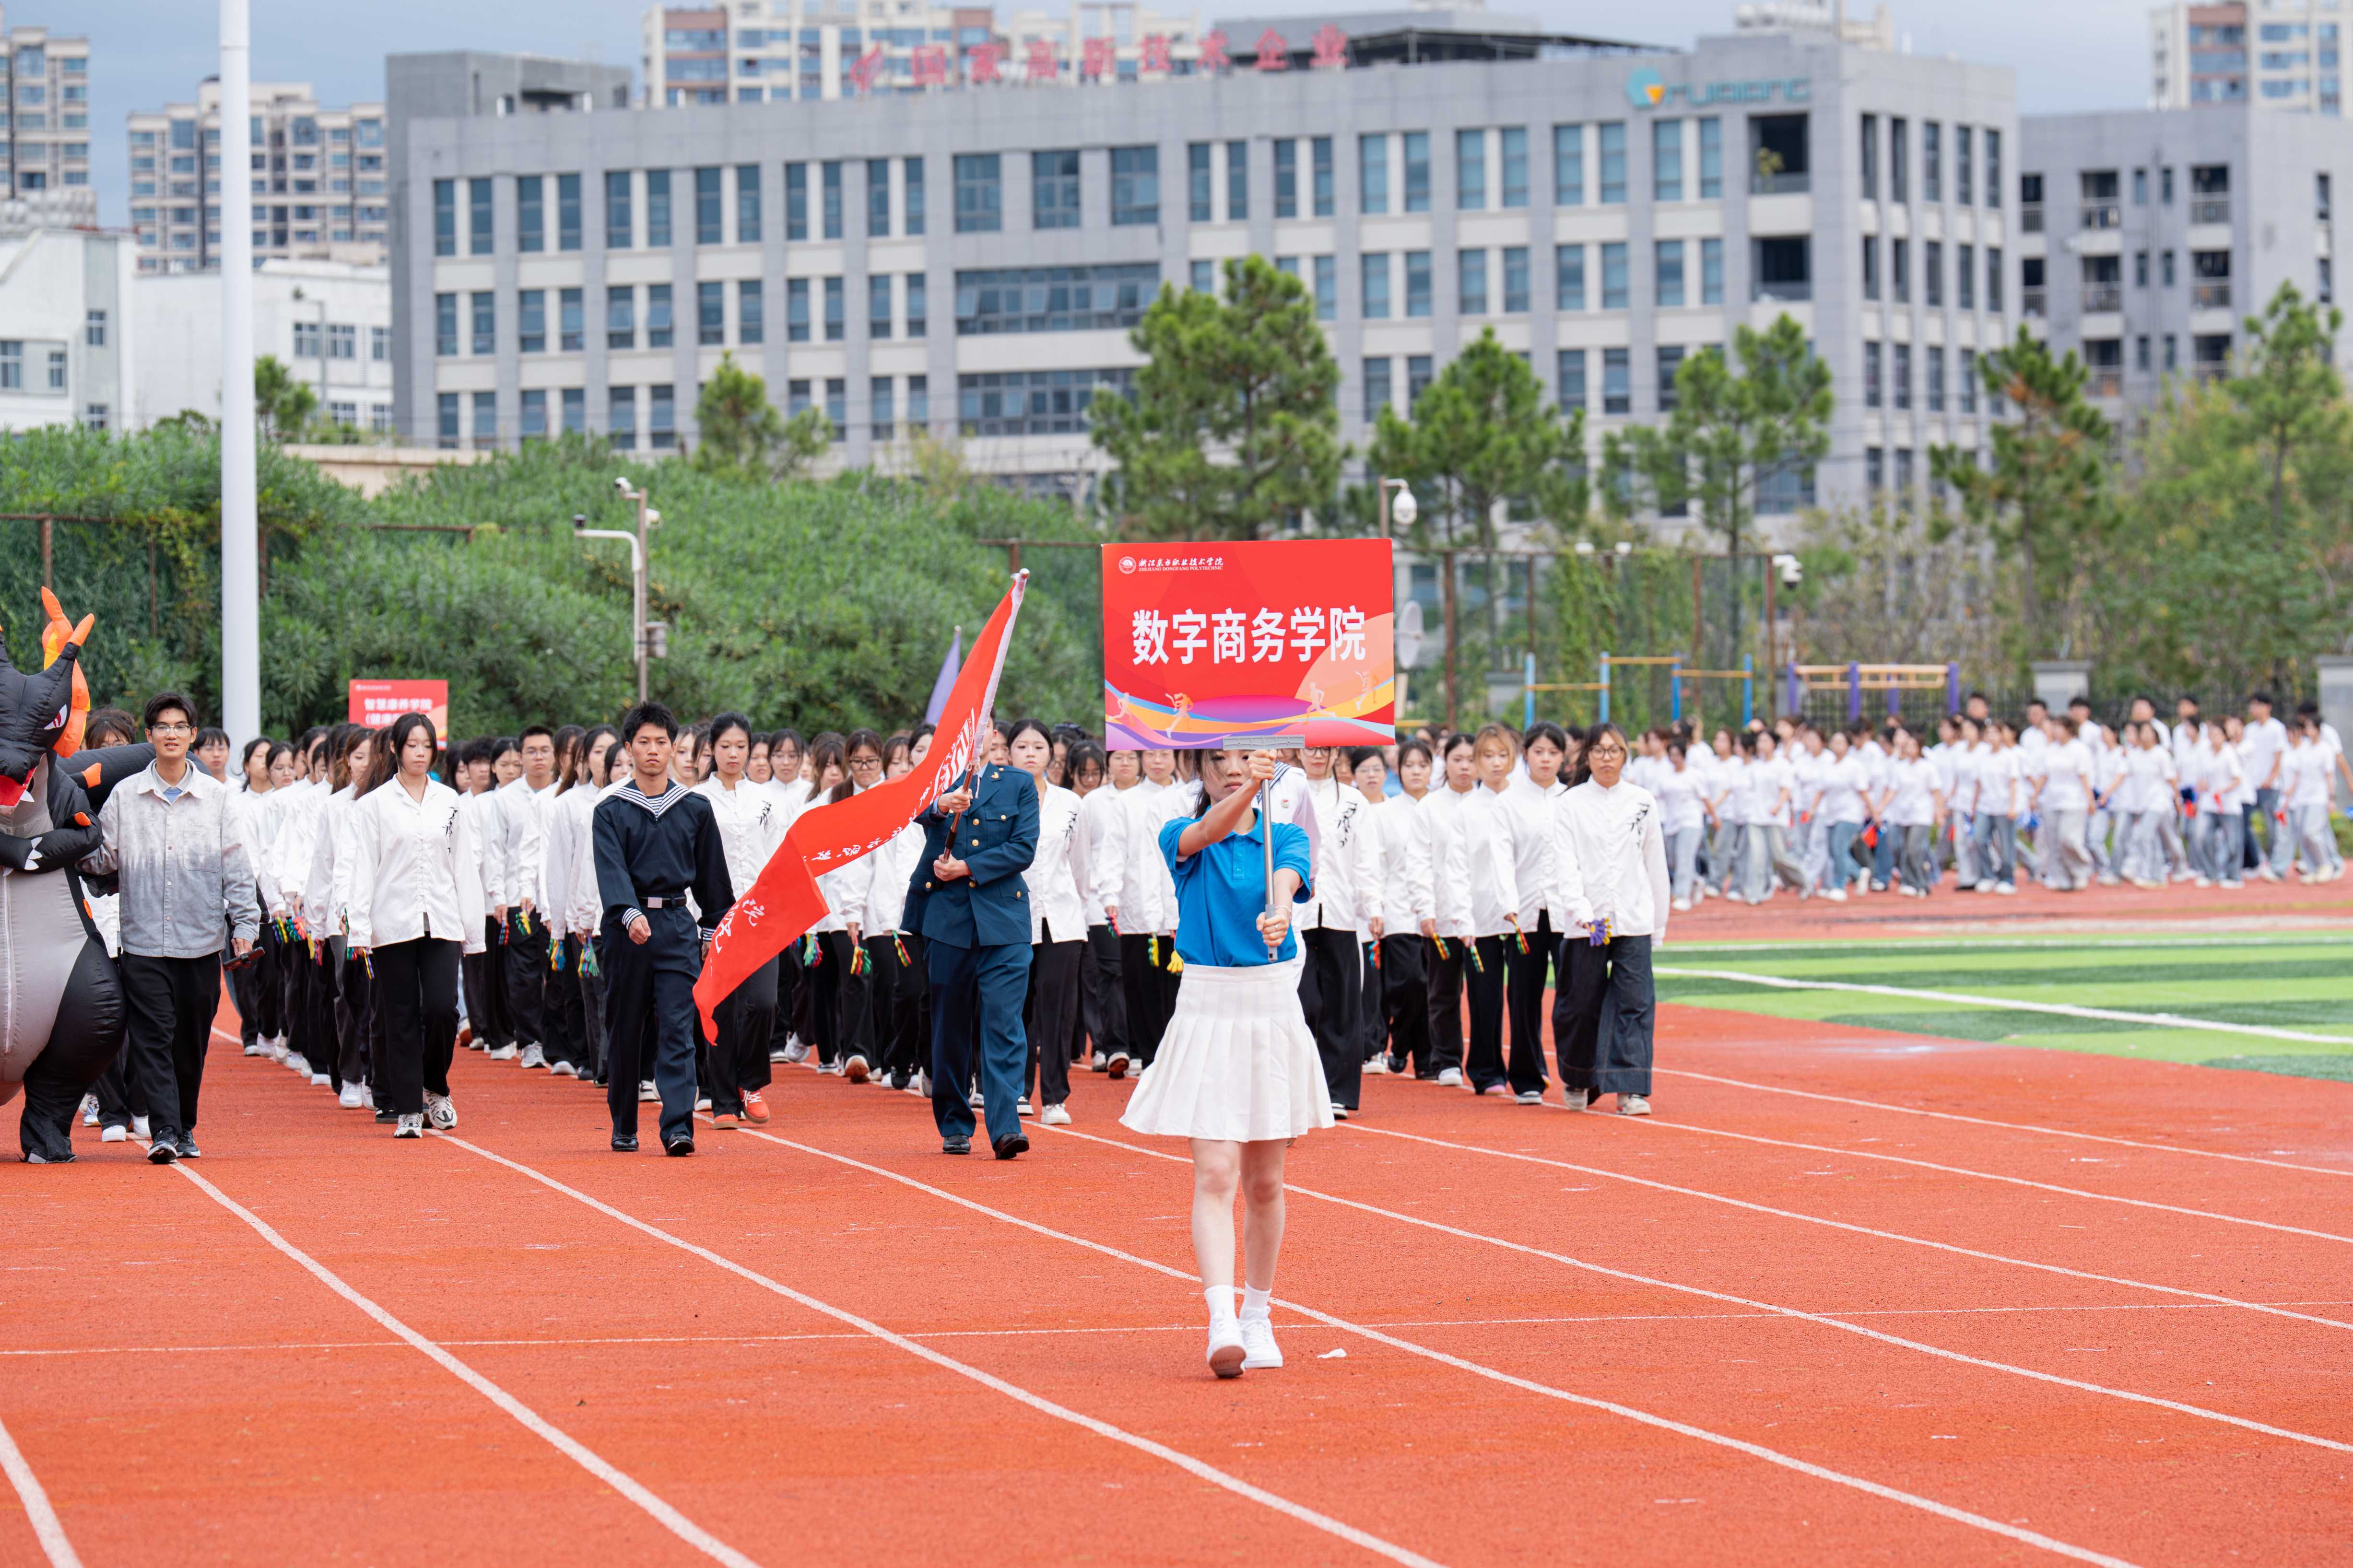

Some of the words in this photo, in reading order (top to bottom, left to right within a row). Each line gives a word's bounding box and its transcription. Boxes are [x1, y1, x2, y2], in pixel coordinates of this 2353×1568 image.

[1139, 557, 1224, 567] 浙江东方职业技术学院
[1132, 605, 1366, 665] 数字商务学院
[365, 698, 433, 711] 智慧康养学院
